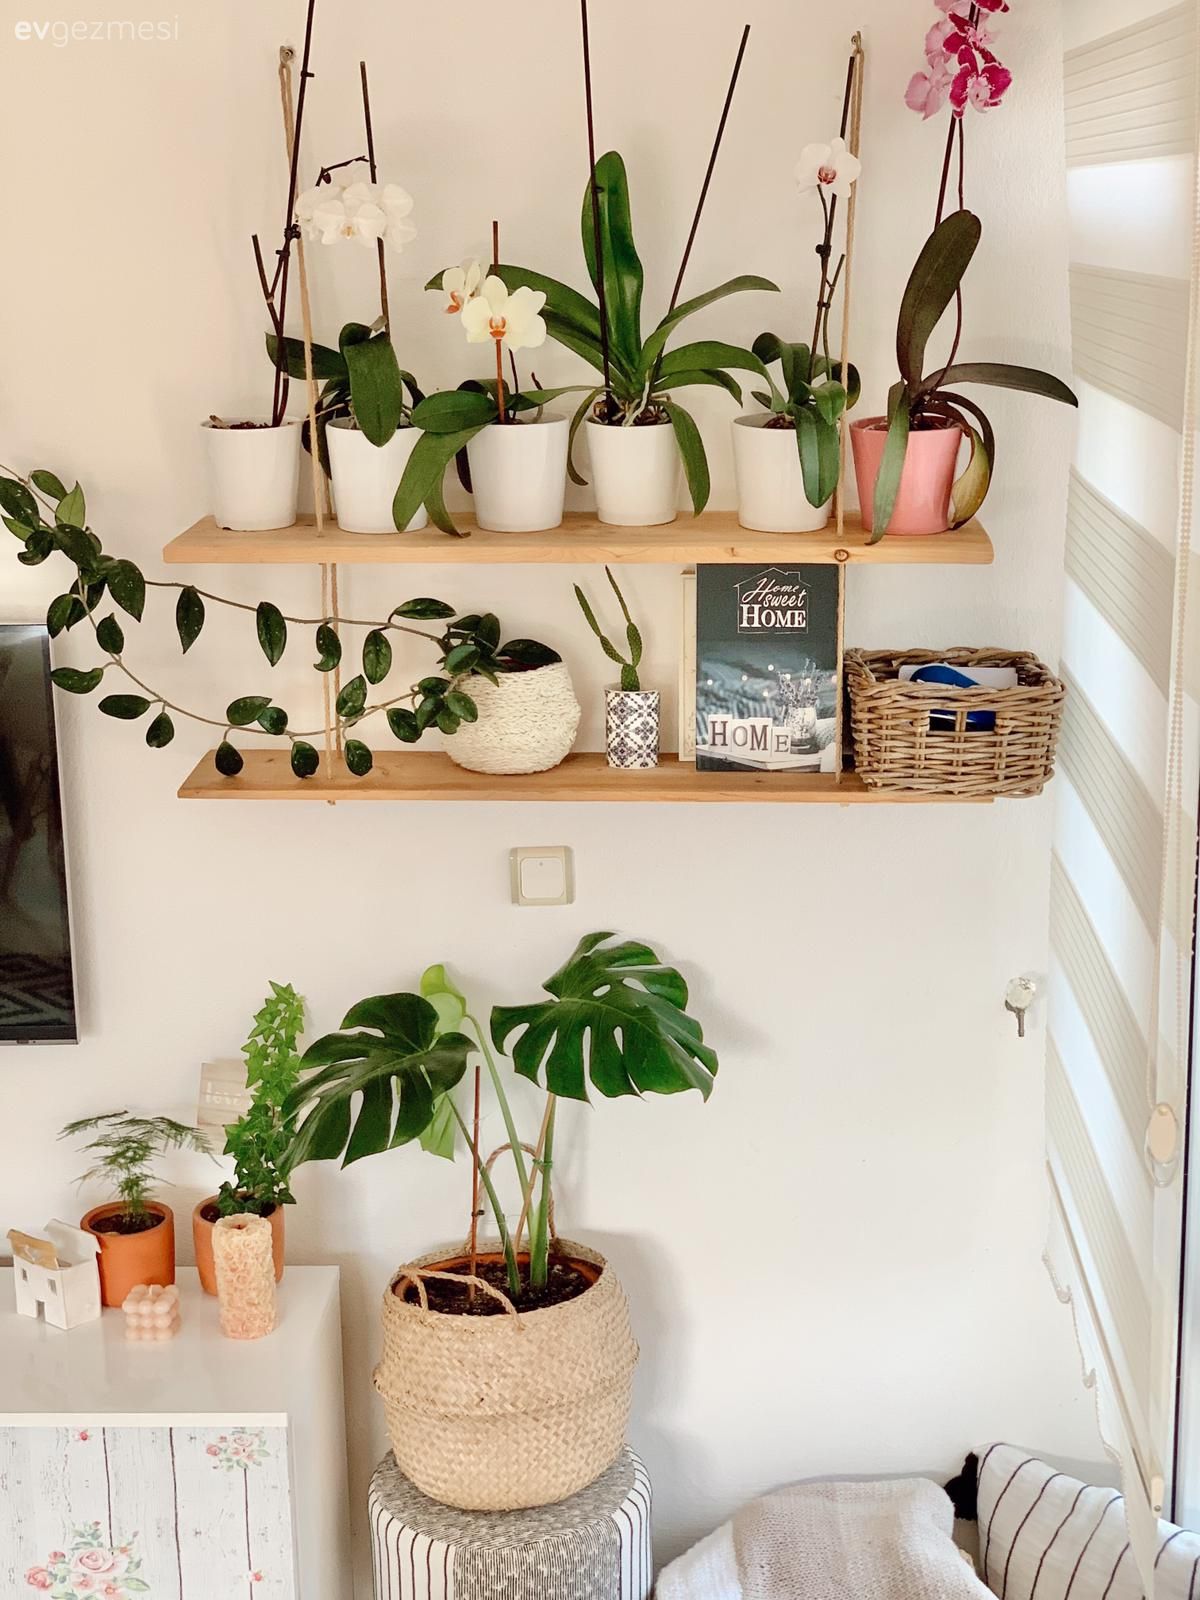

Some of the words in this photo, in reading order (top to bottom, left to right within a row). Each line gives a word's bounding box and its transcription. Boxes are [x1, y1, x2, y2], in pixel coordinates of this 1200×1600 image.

[741, 577, 800, 603] Home
[763, 588, 807, 608] sweet
[740, 603, 806, 628] HOME
[709, 720, 790, 753] HOME
